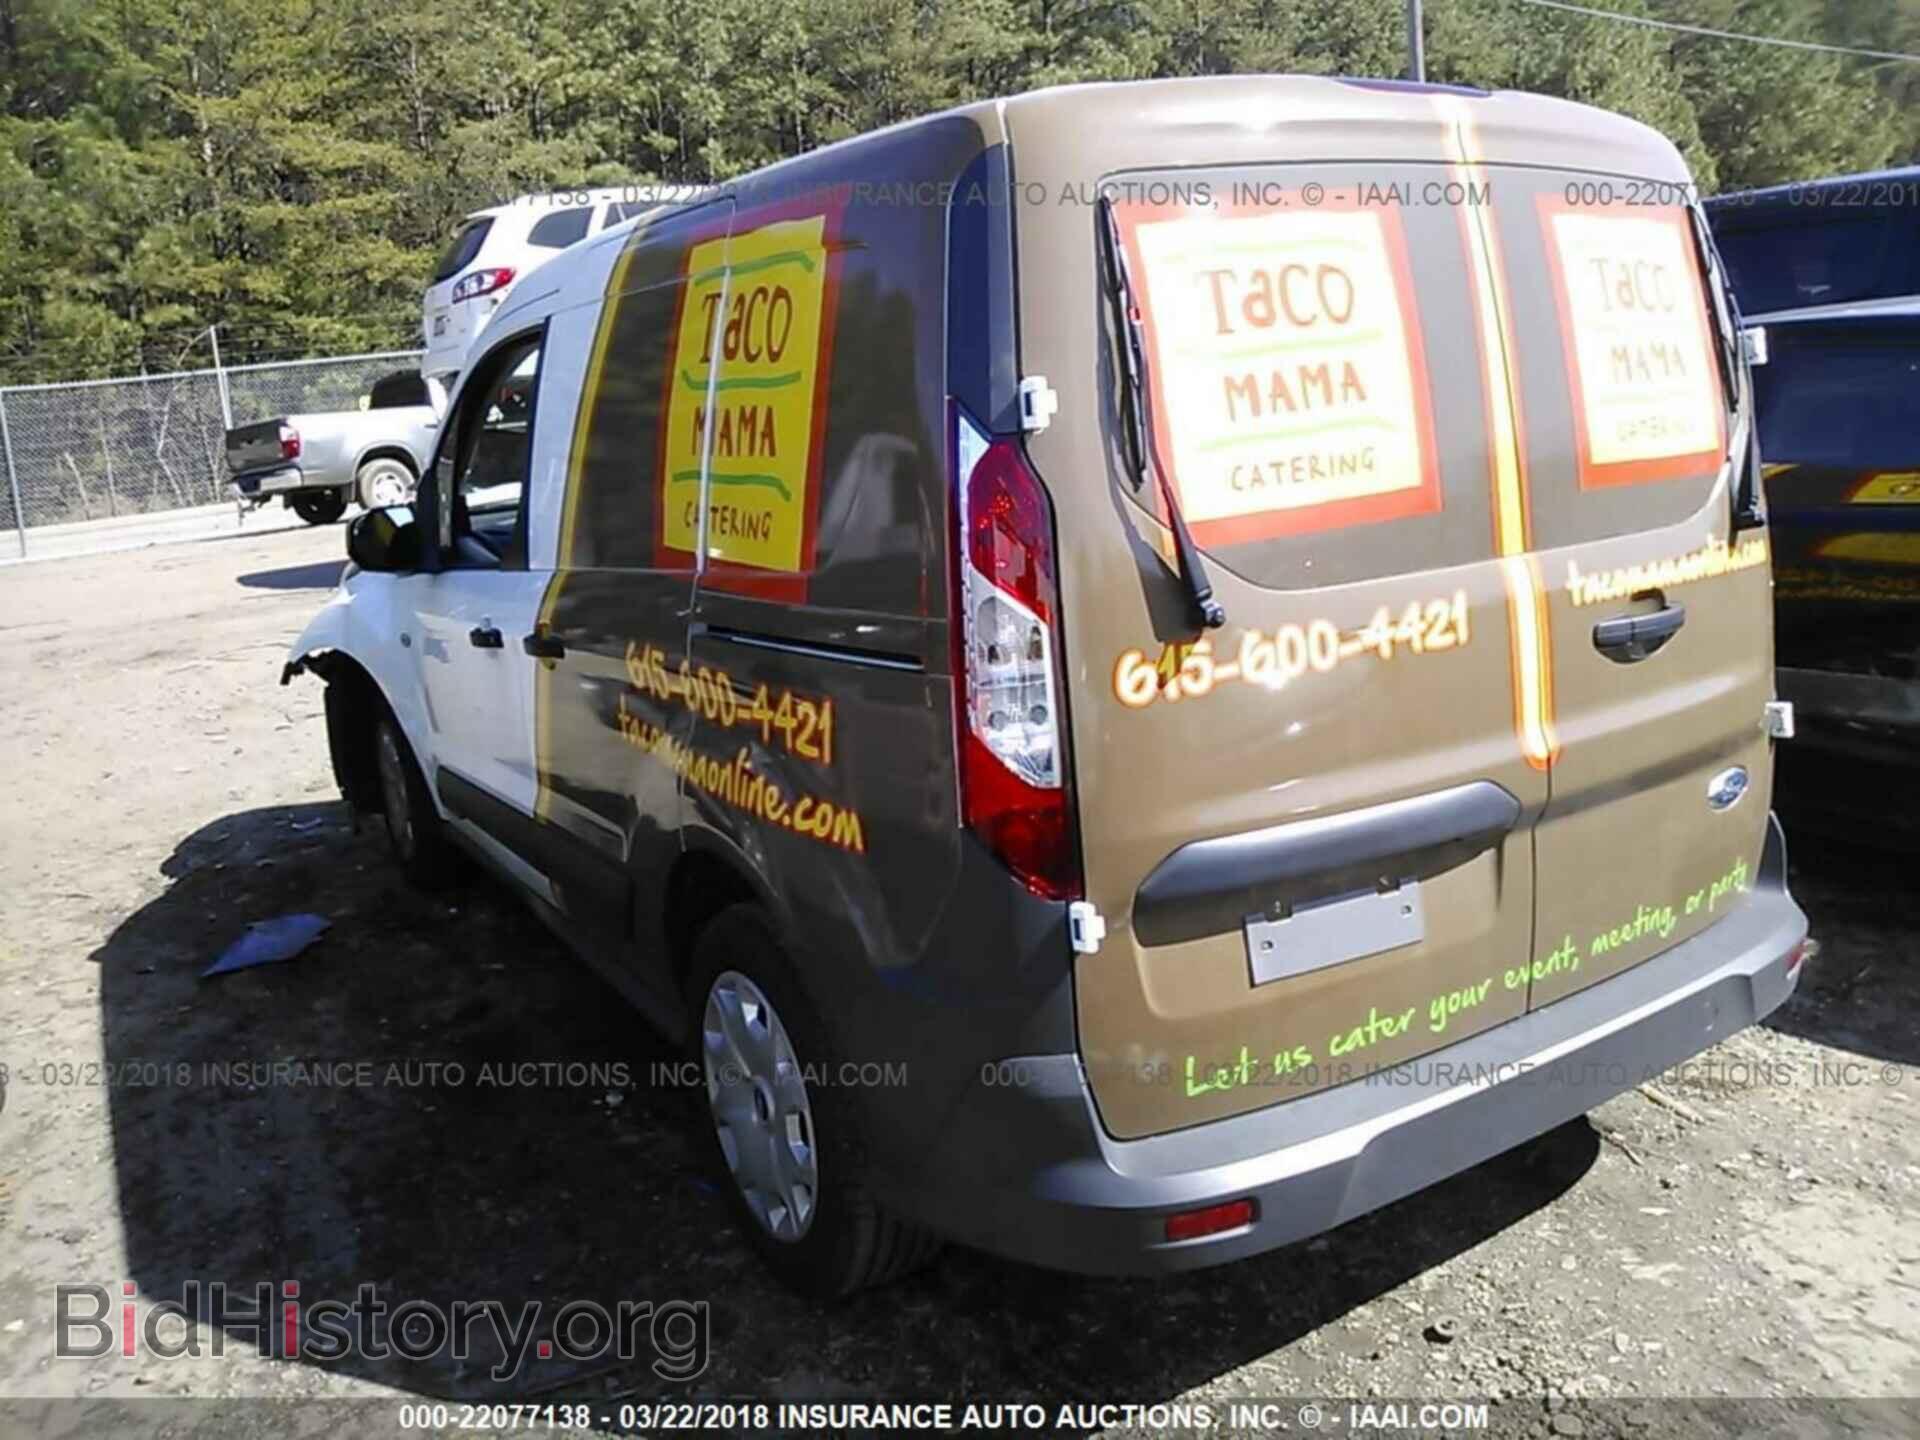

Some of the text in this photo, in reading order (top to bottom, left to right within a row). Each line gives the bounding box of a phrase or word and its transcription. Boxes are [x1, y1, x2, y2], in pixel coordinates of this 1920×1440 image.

[692, 405, 777, 458] MAMA
[1224, 361, 1368, 421] MAMA
[1230, 447, 1375, 492] CATERING
[1114, 589, 1472, 709] 615-600-4421
[624, 641, 833, 766] 615-600-4421
[1185, 1046, 1258, 1097] Let
[1273, 1045, 1313, 1076] us
[1328, 1007, 1416, 1057] cater
[1428, 977, 1493, 1032] your
[1504, 935, 1580, 990] event,
[1592, 904, 1677, 956] meeting,
[1685, 890, 1705, 915] or
